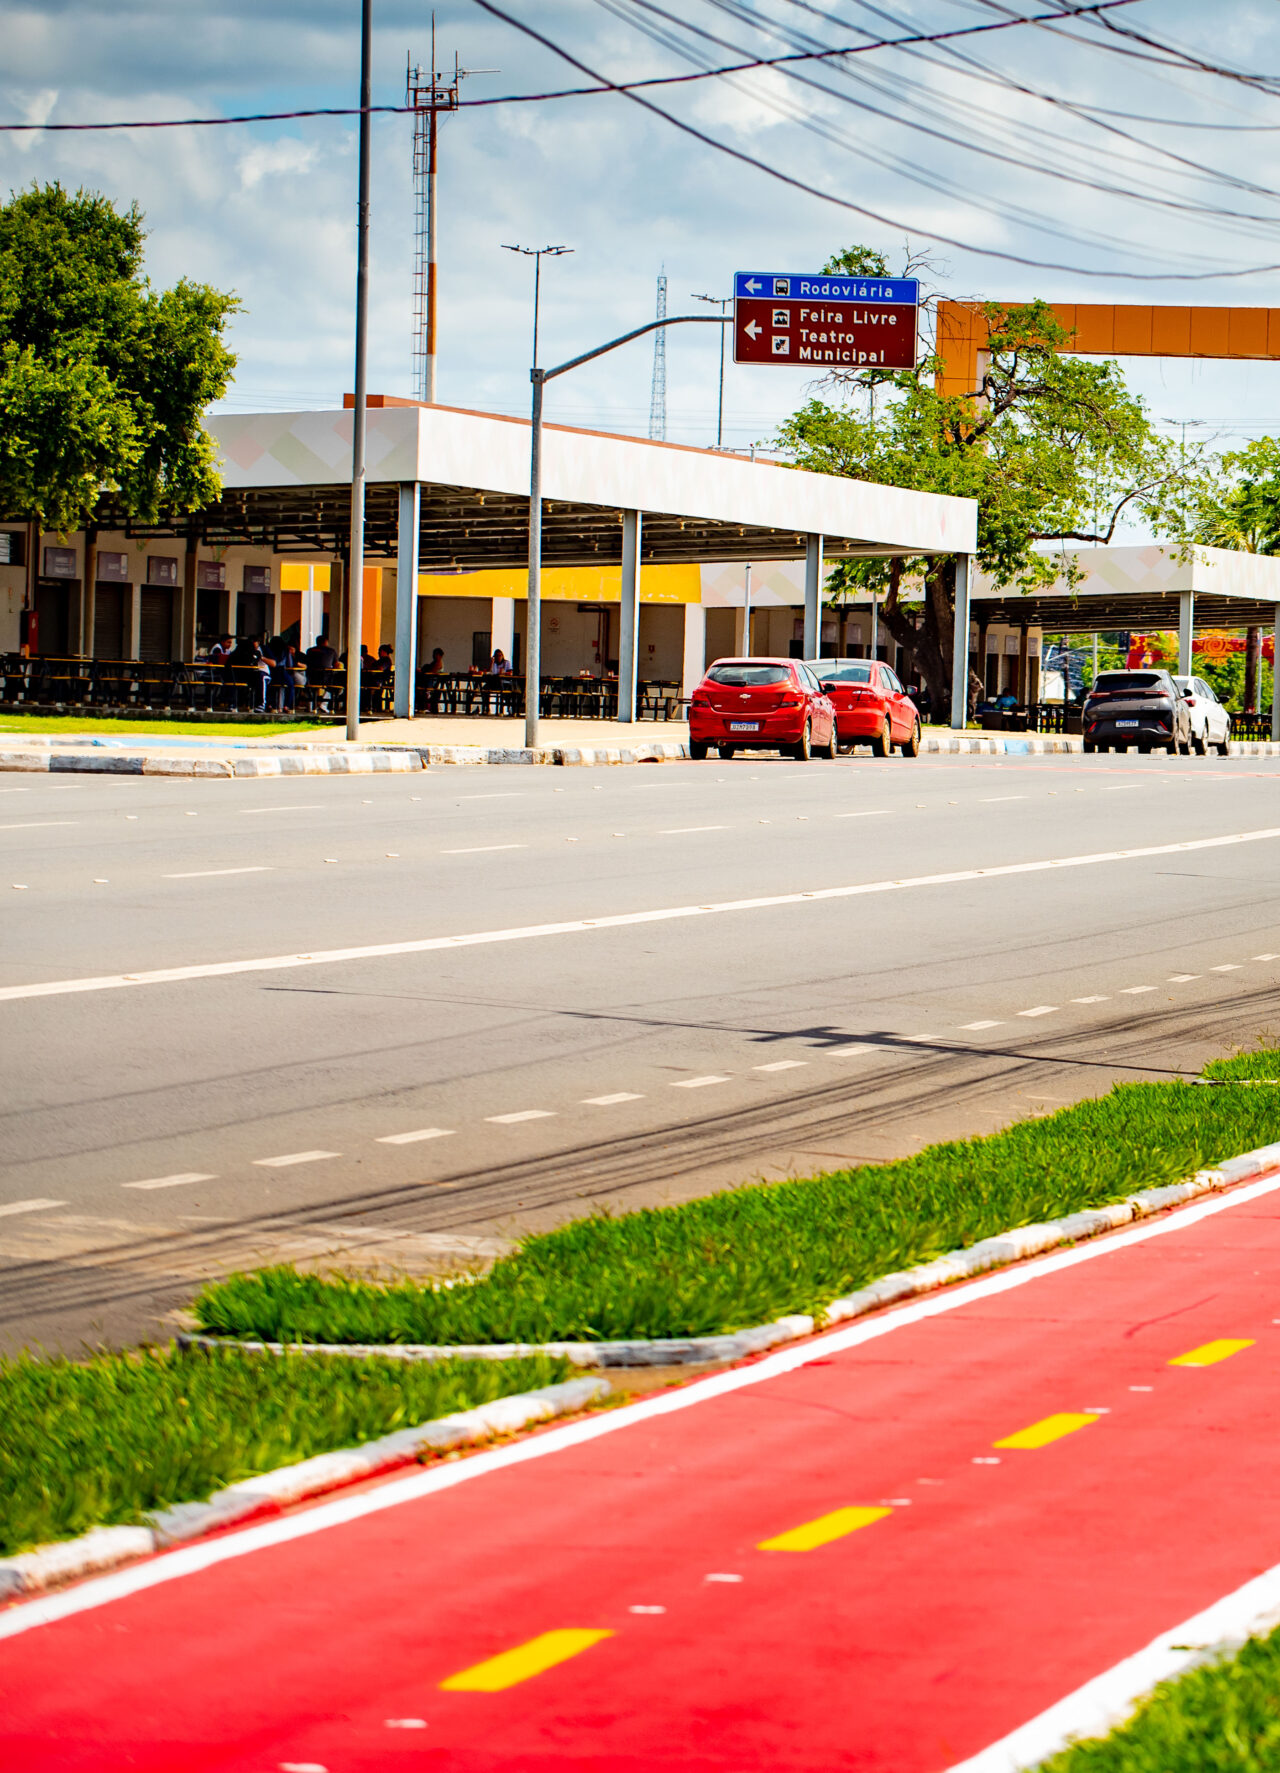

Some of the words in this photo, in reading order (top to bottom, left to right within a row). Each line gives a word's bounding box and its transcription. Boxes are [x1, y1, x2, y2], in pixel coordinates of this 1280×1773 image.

[800, 282, 893, 298] Rodoviária
[800, 309, 843, 323] Feira
[853, 310, 897, 325] Livre
[800, 329, 855, 344] Teatro
[799, 346, 885, 364] Municipal
